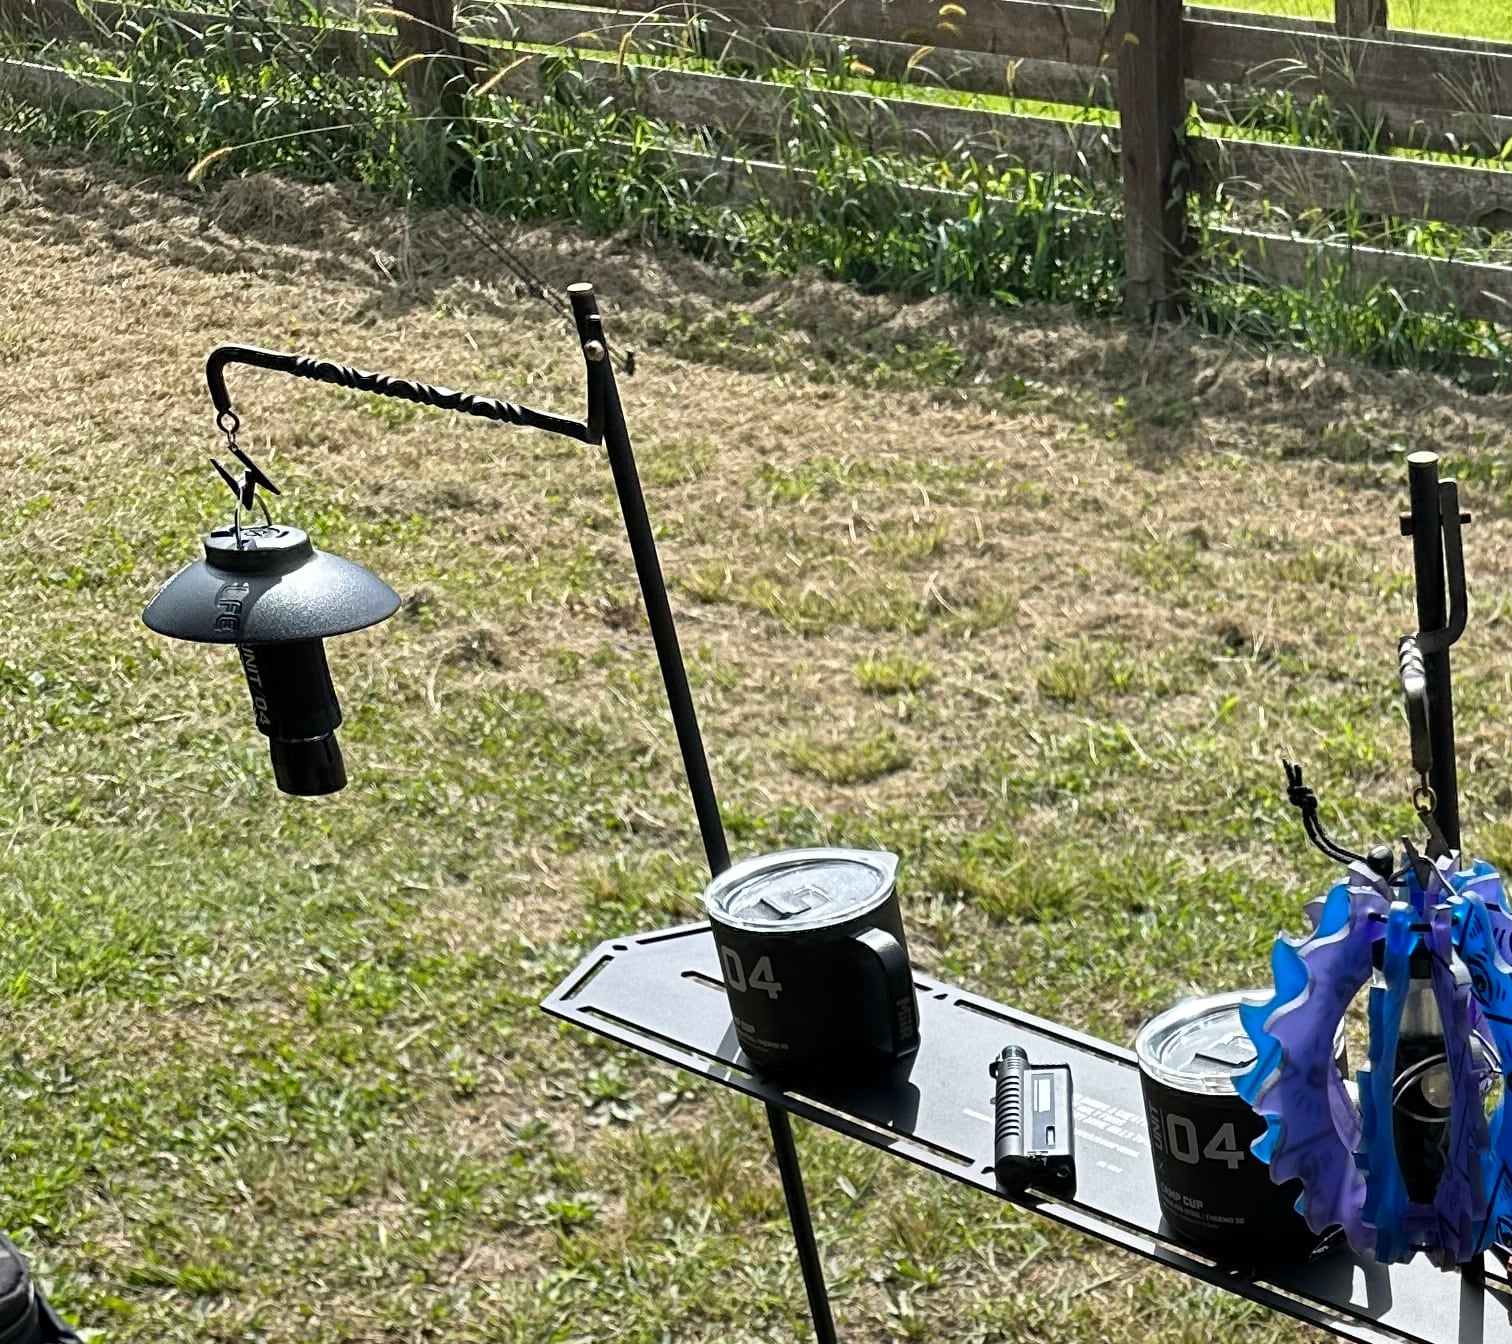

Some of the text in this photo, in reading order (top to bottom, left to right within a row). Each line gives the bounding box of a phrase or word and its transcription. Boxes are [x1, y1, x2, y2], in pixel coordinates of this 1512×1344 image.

[721, 944, 783, 1000] 04
[1150, 1107, 1163, 1151] UNIT
[1166, 1113, 1245, 1170] 04
[1183, 1195, 1203, 1209] CUP
